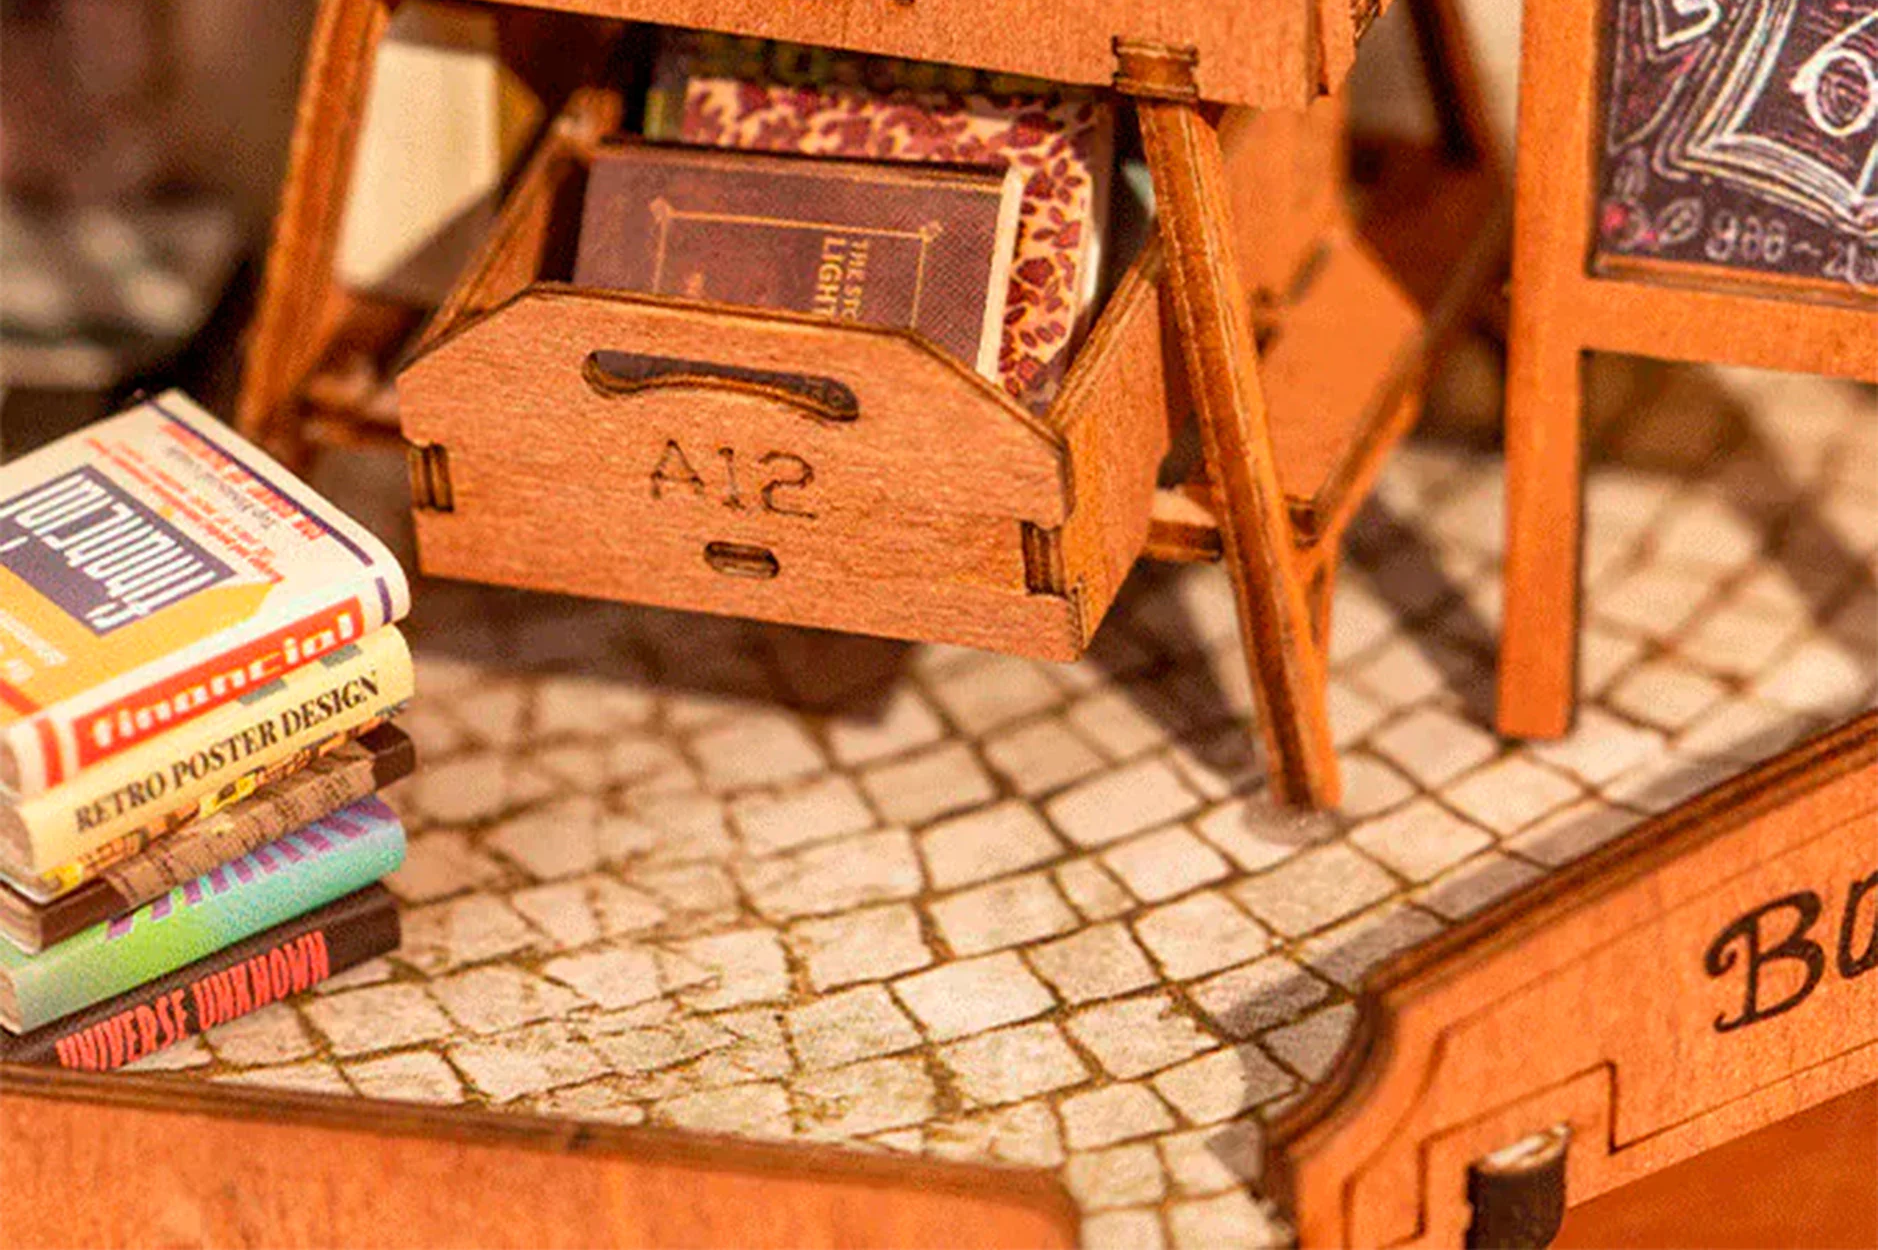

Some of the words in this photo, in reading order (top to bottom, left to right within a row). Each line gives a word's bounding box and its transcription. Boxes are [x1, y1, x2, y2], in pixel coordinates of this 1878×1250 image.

[811, 235, 847, 323] LIGHT
[845, 238, 869, 282] THE
[649, 439, 818, 520] A12
[0, 472, 217, 630] financial
[92, 611, 354, 750] financial
[74, 769, 168, 833] RETRO
[169, 717, 278, 792] POSTER
[279, 669, 380, 738] DESIGN
[55, 988, 190, 1072] UNIVERSE
[191, 930, 331, 1031] UNKNOWN
